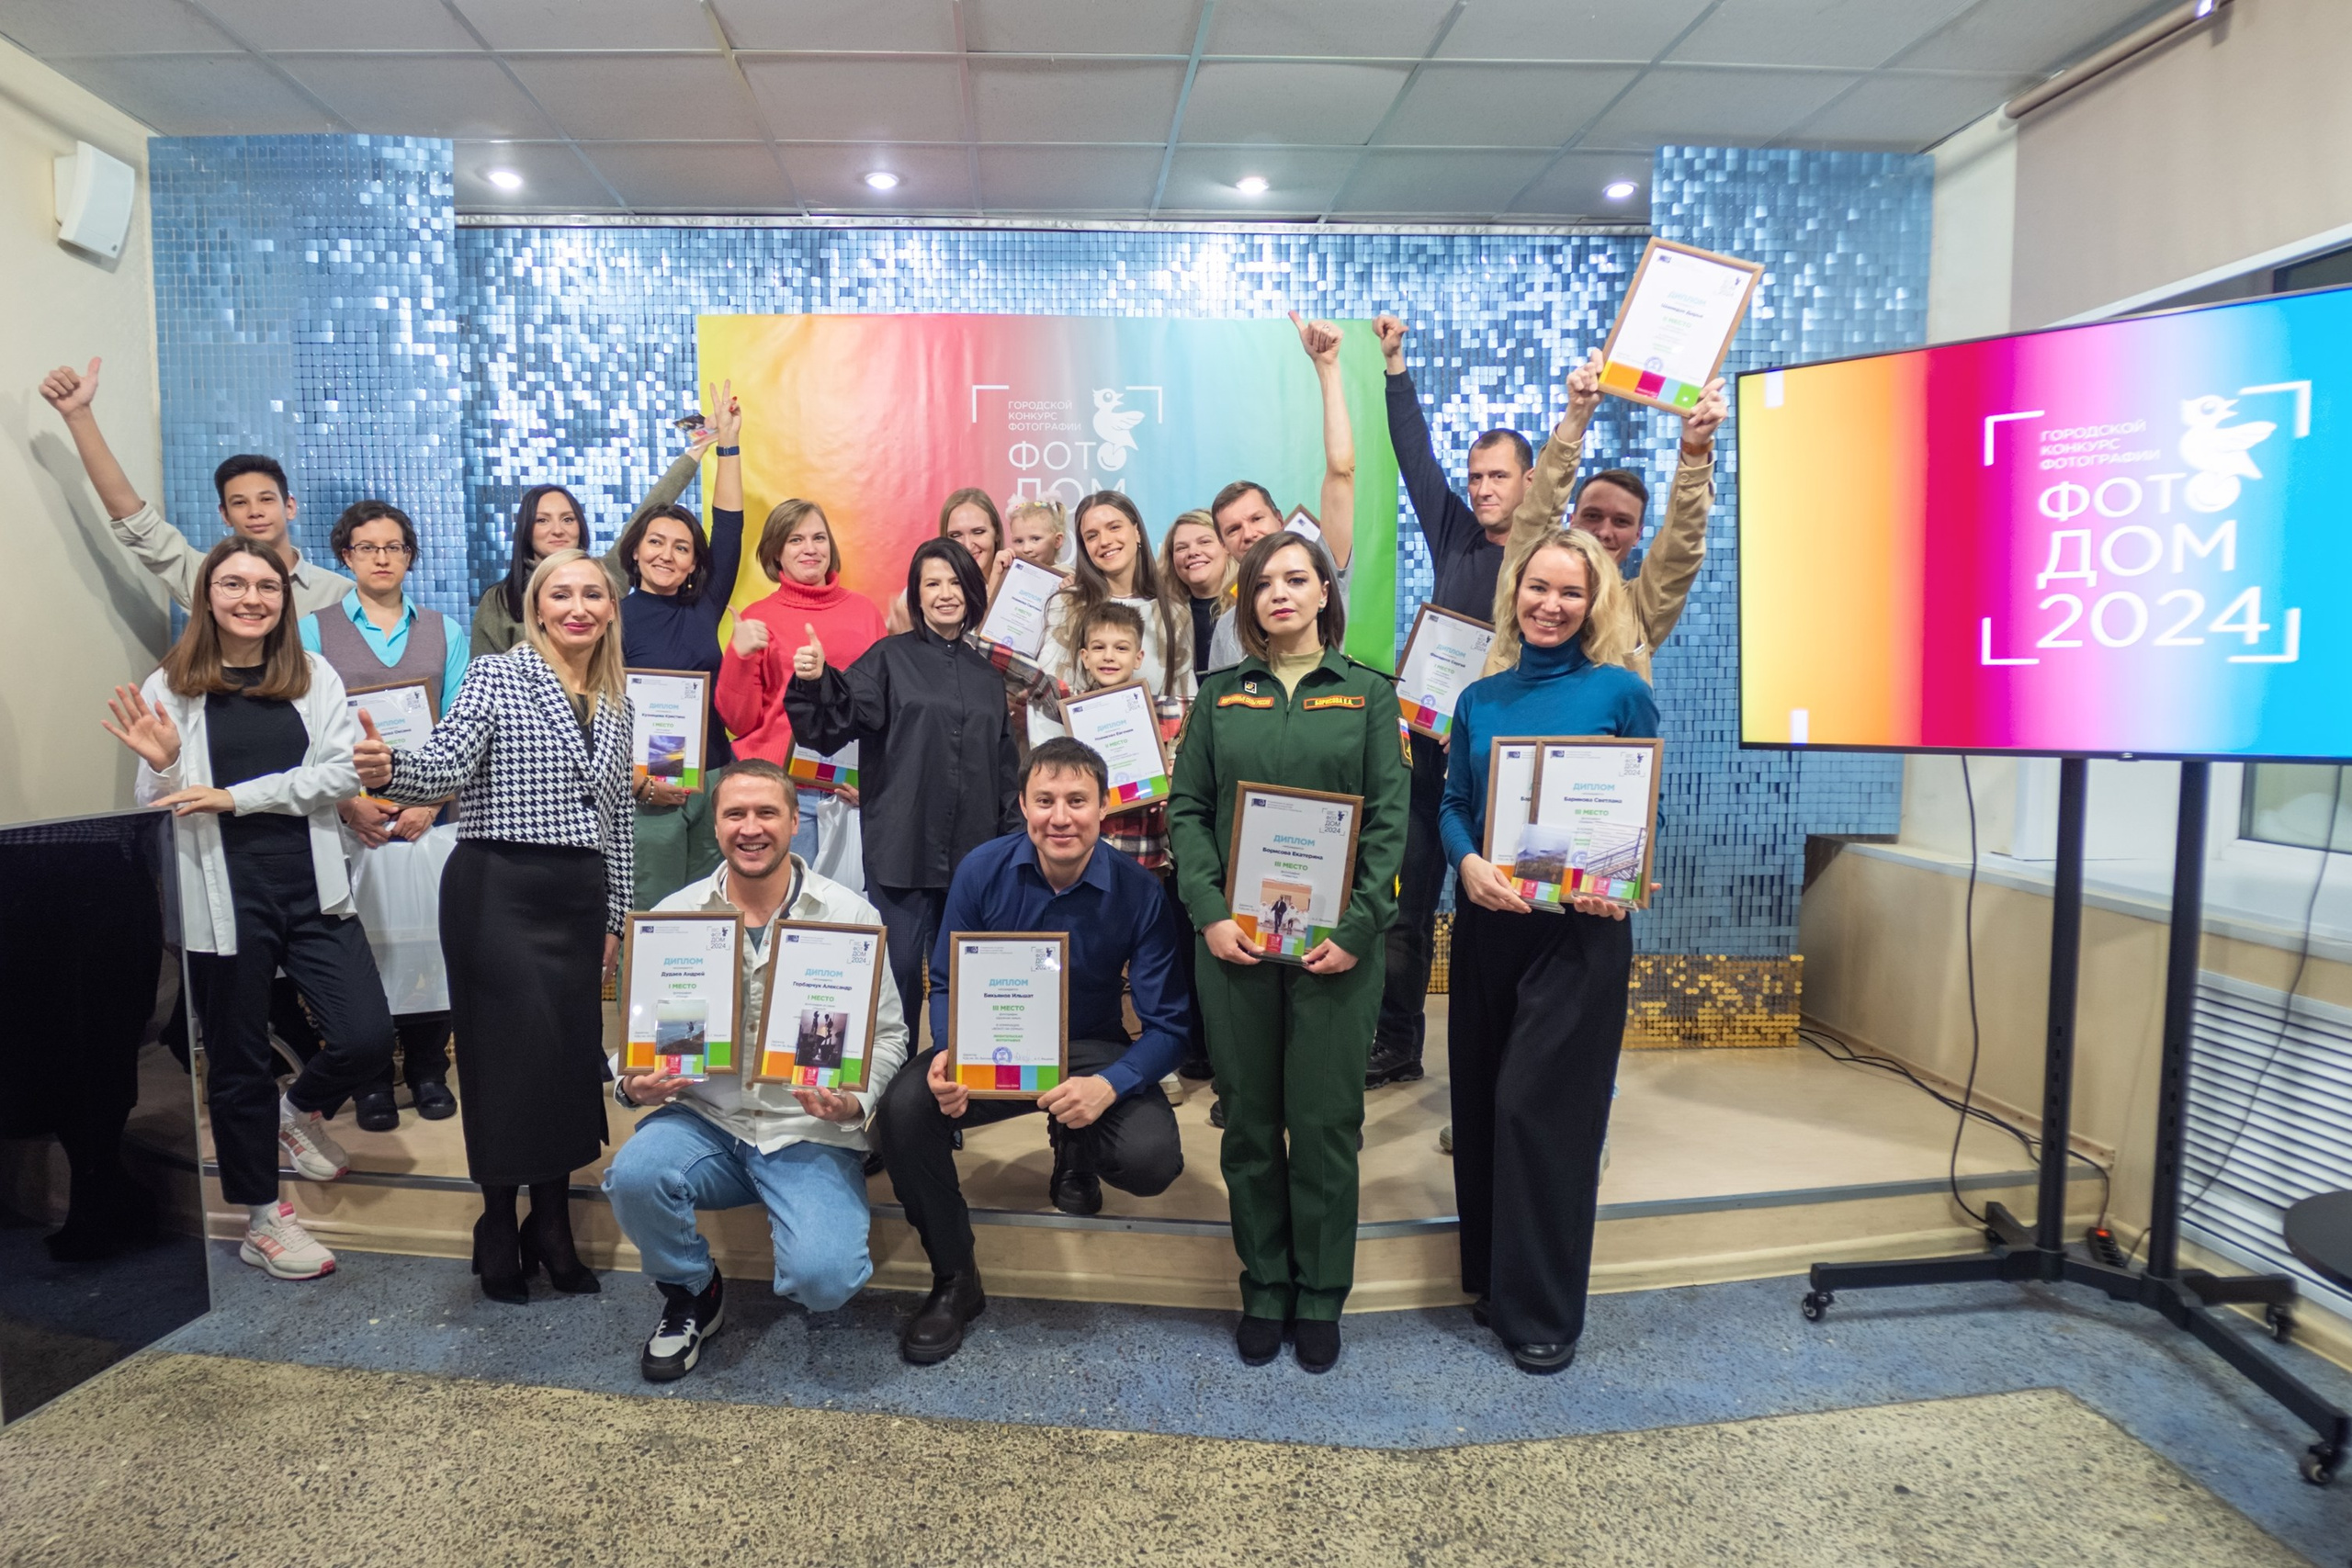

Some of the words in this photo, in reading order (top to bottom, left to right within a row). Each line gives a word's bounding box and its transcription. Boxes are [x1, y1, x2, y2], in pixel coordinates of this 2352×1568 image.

[1008, 400, 1072, 410] ГОРОДСКОЙ
[1008, 412, 1057, 421] КОНКУРС
[1008, 422, 1081, 432] ФОТОГРАФИИ
[2040, 419, 2148, 442] ГОРОДСКОЙ
[2040, 437, 2121, 456] КОНКУРС
[2040, 449, 2162, 470] ФОТОГРАФИИ
[2037, 520, 2238, 589] ДОМ
[2036, 586, 2271, 649] 2024
[1573, 783, 1615, 792] ДИПЛОМ
[1273, 834, 1315, 847] ДИПЛОМ
[1262, 847, 1291, 856] Борисова
[1292, 852, 1323, 860] Екатерина
[1283, 863, 1308, 871] МЕСТО
[663, 957, 704, 965] ДИПЛОМ
[805, 968, 843, 978] ДИПЛОМ
[989, 978, 1028, 987] ДИПЛОМ
